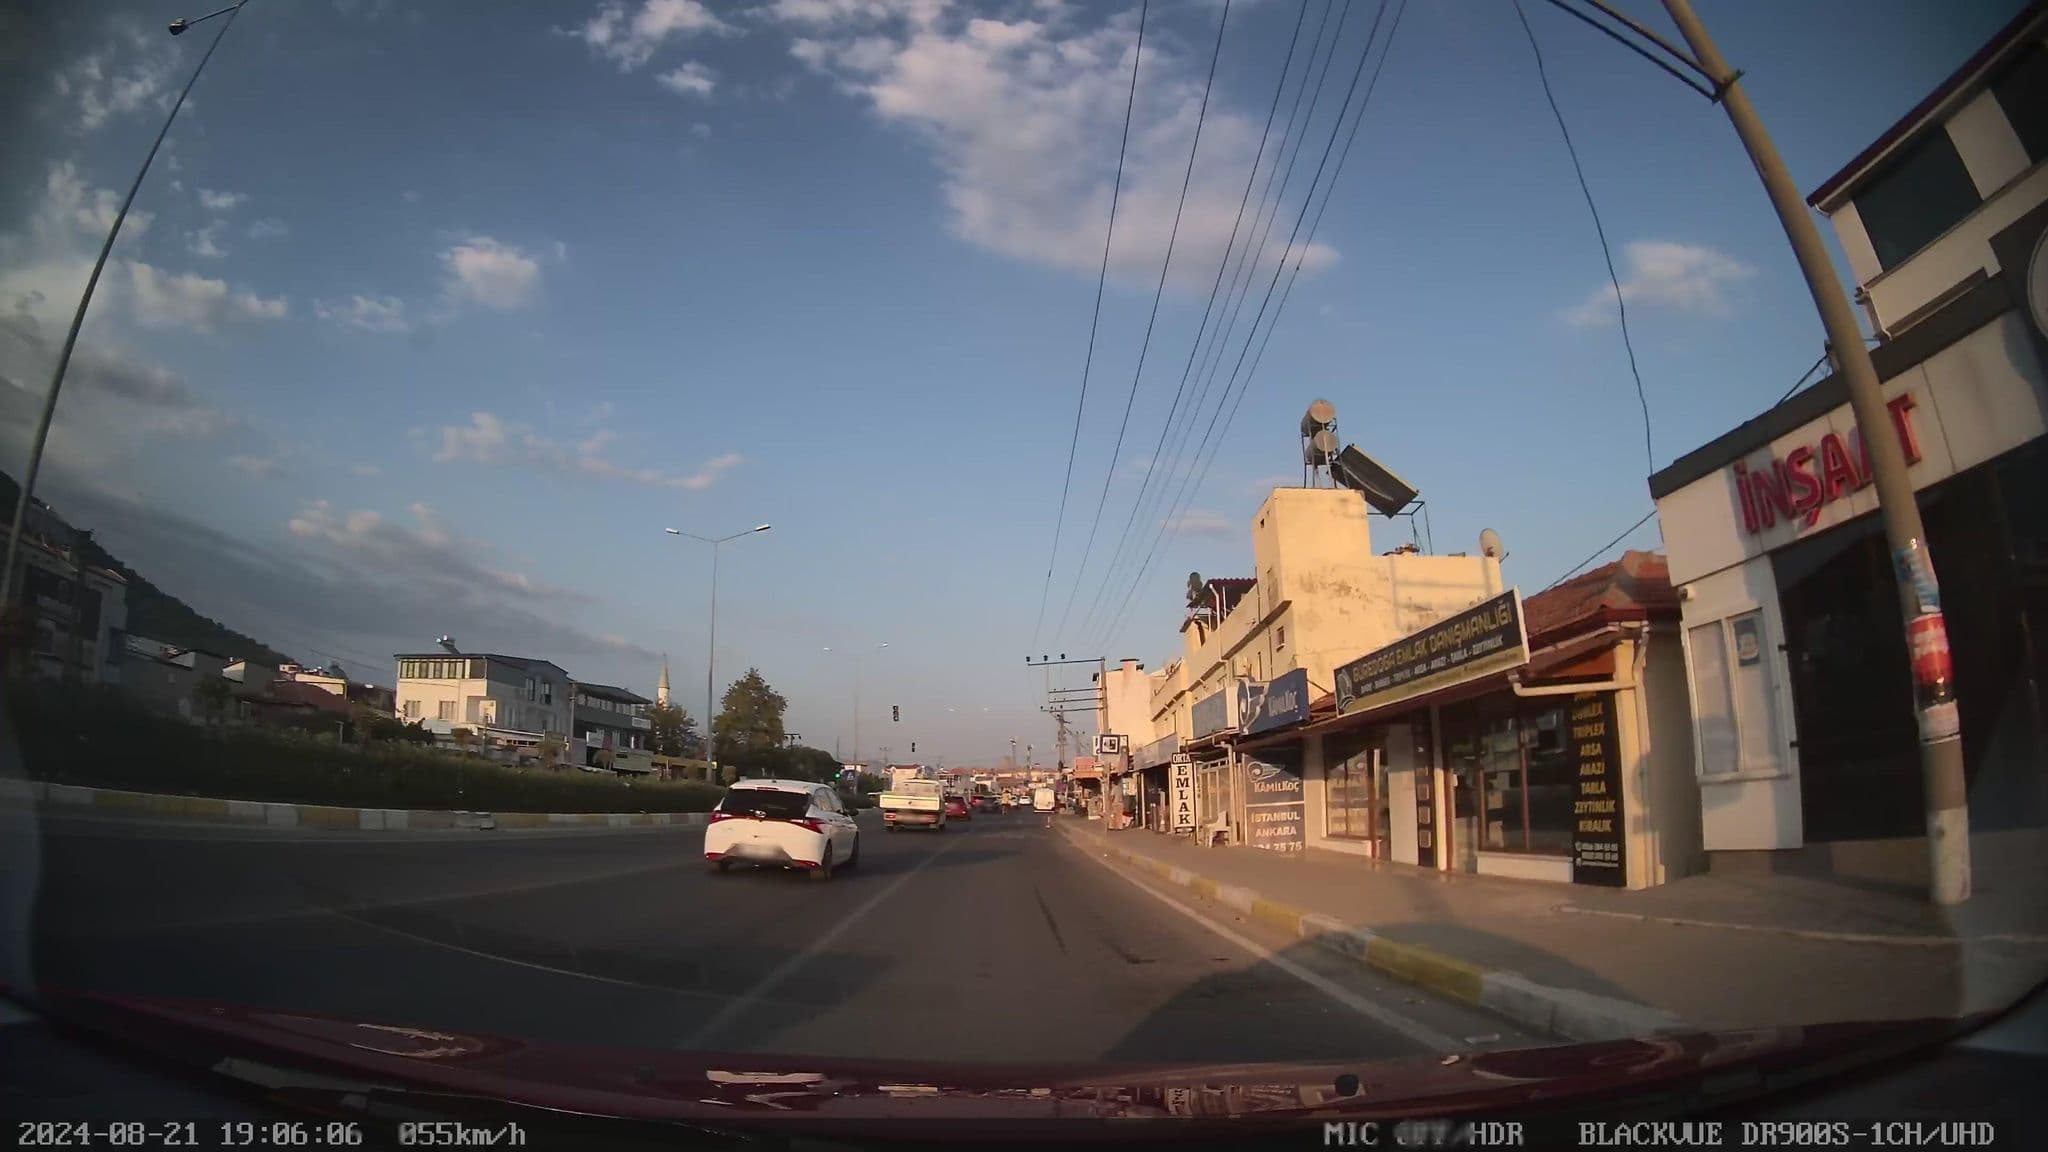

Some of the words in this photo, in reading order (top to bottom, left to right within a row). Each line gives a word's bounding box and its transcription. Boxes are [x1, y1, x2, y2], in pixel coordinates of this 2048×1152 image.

[1396, 634, 1429, 665] EMLAK
[1176, 766, 1191, 824] EMLAK
[1255, 826, 1297, 838] ANKARA
